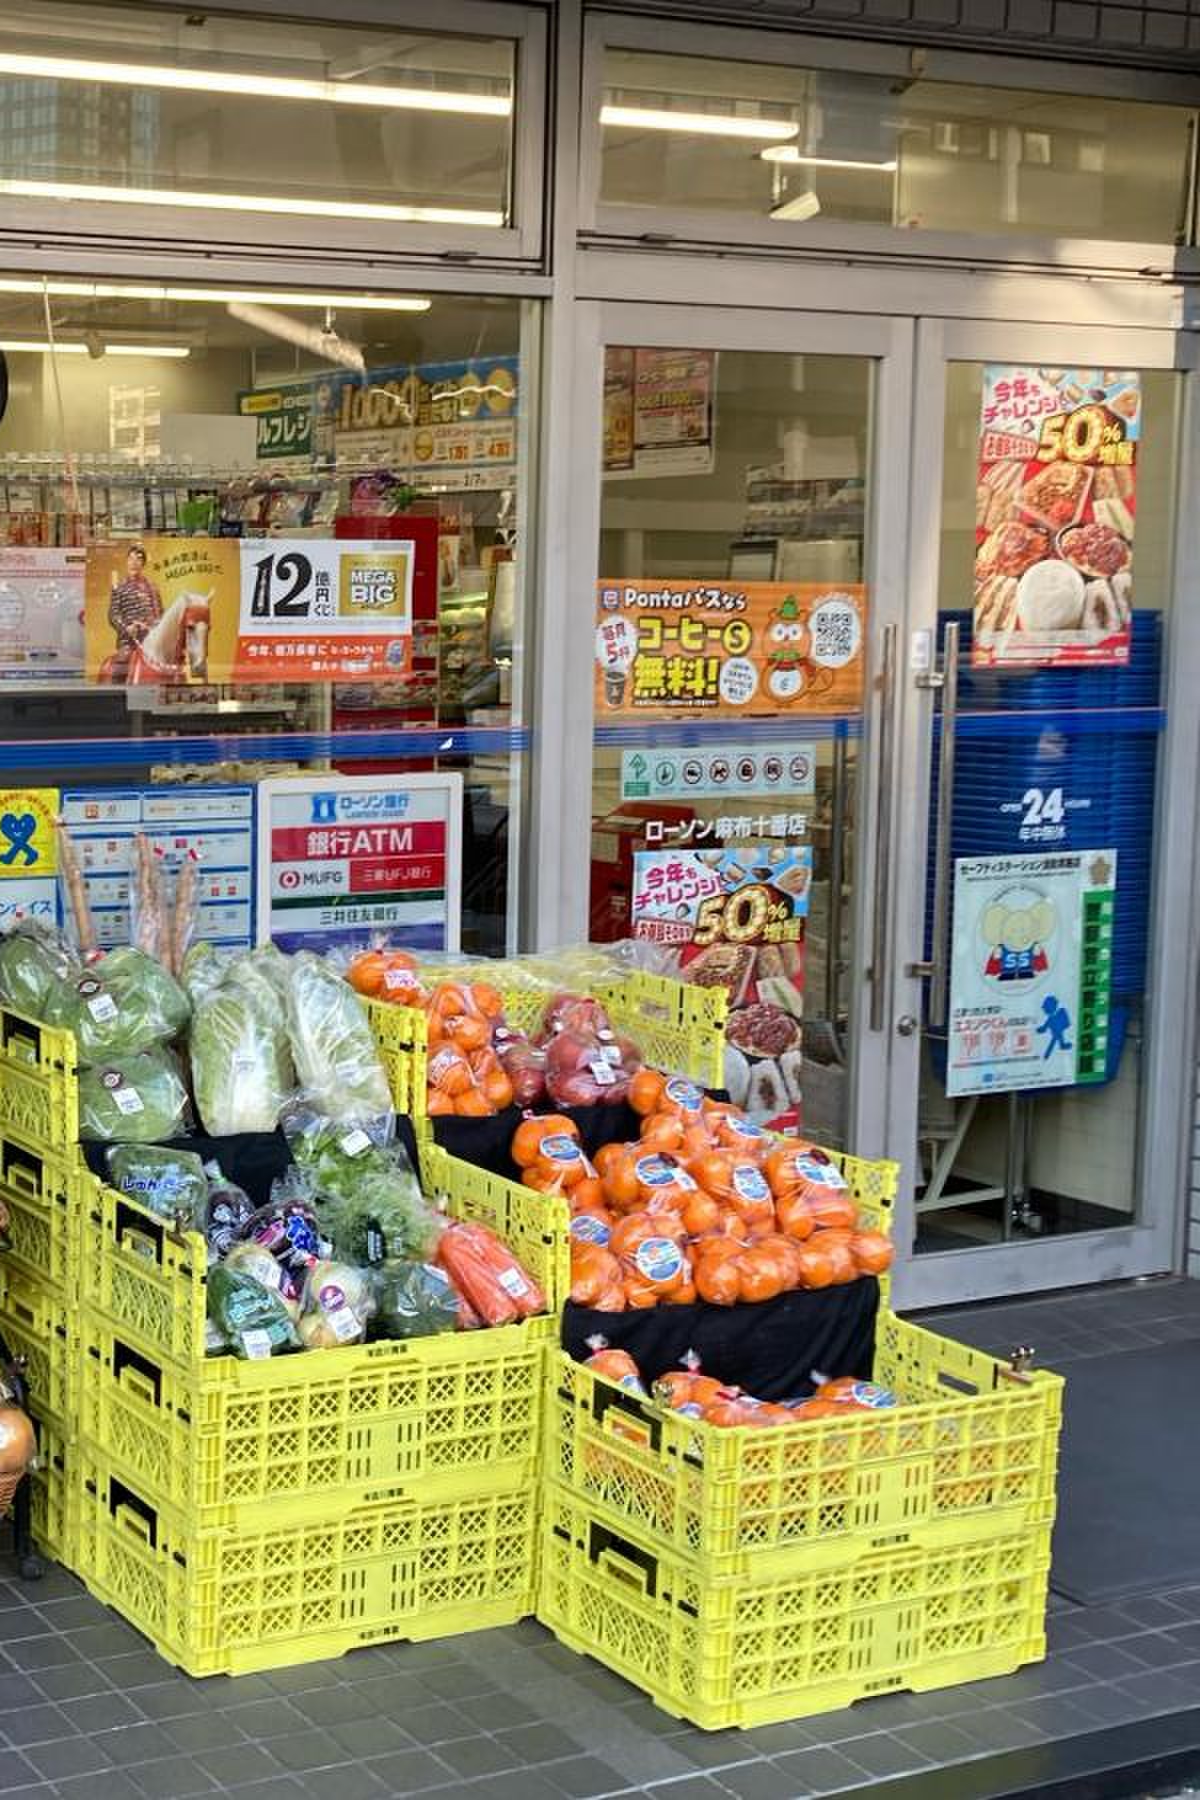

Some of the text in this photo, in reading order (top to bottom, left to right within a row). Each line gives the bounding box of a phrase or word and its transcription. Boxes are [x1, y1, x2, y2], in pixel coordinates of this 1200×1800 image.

[251, 552, 312, 617] 12
[351, 585, 398, 606] BIG
[634, 656, 719, 697] 無料!
[1022, 787, 1064, 825] 24
[646, 815, 806, 841] ローソン麻布十番店
[307, 827, 413, 857] 銀行ATM
[303, 870, 343, 885] MUFG
[647, 863, 697, 889] 今年も
[1004, 953, 1030, 968] SS
